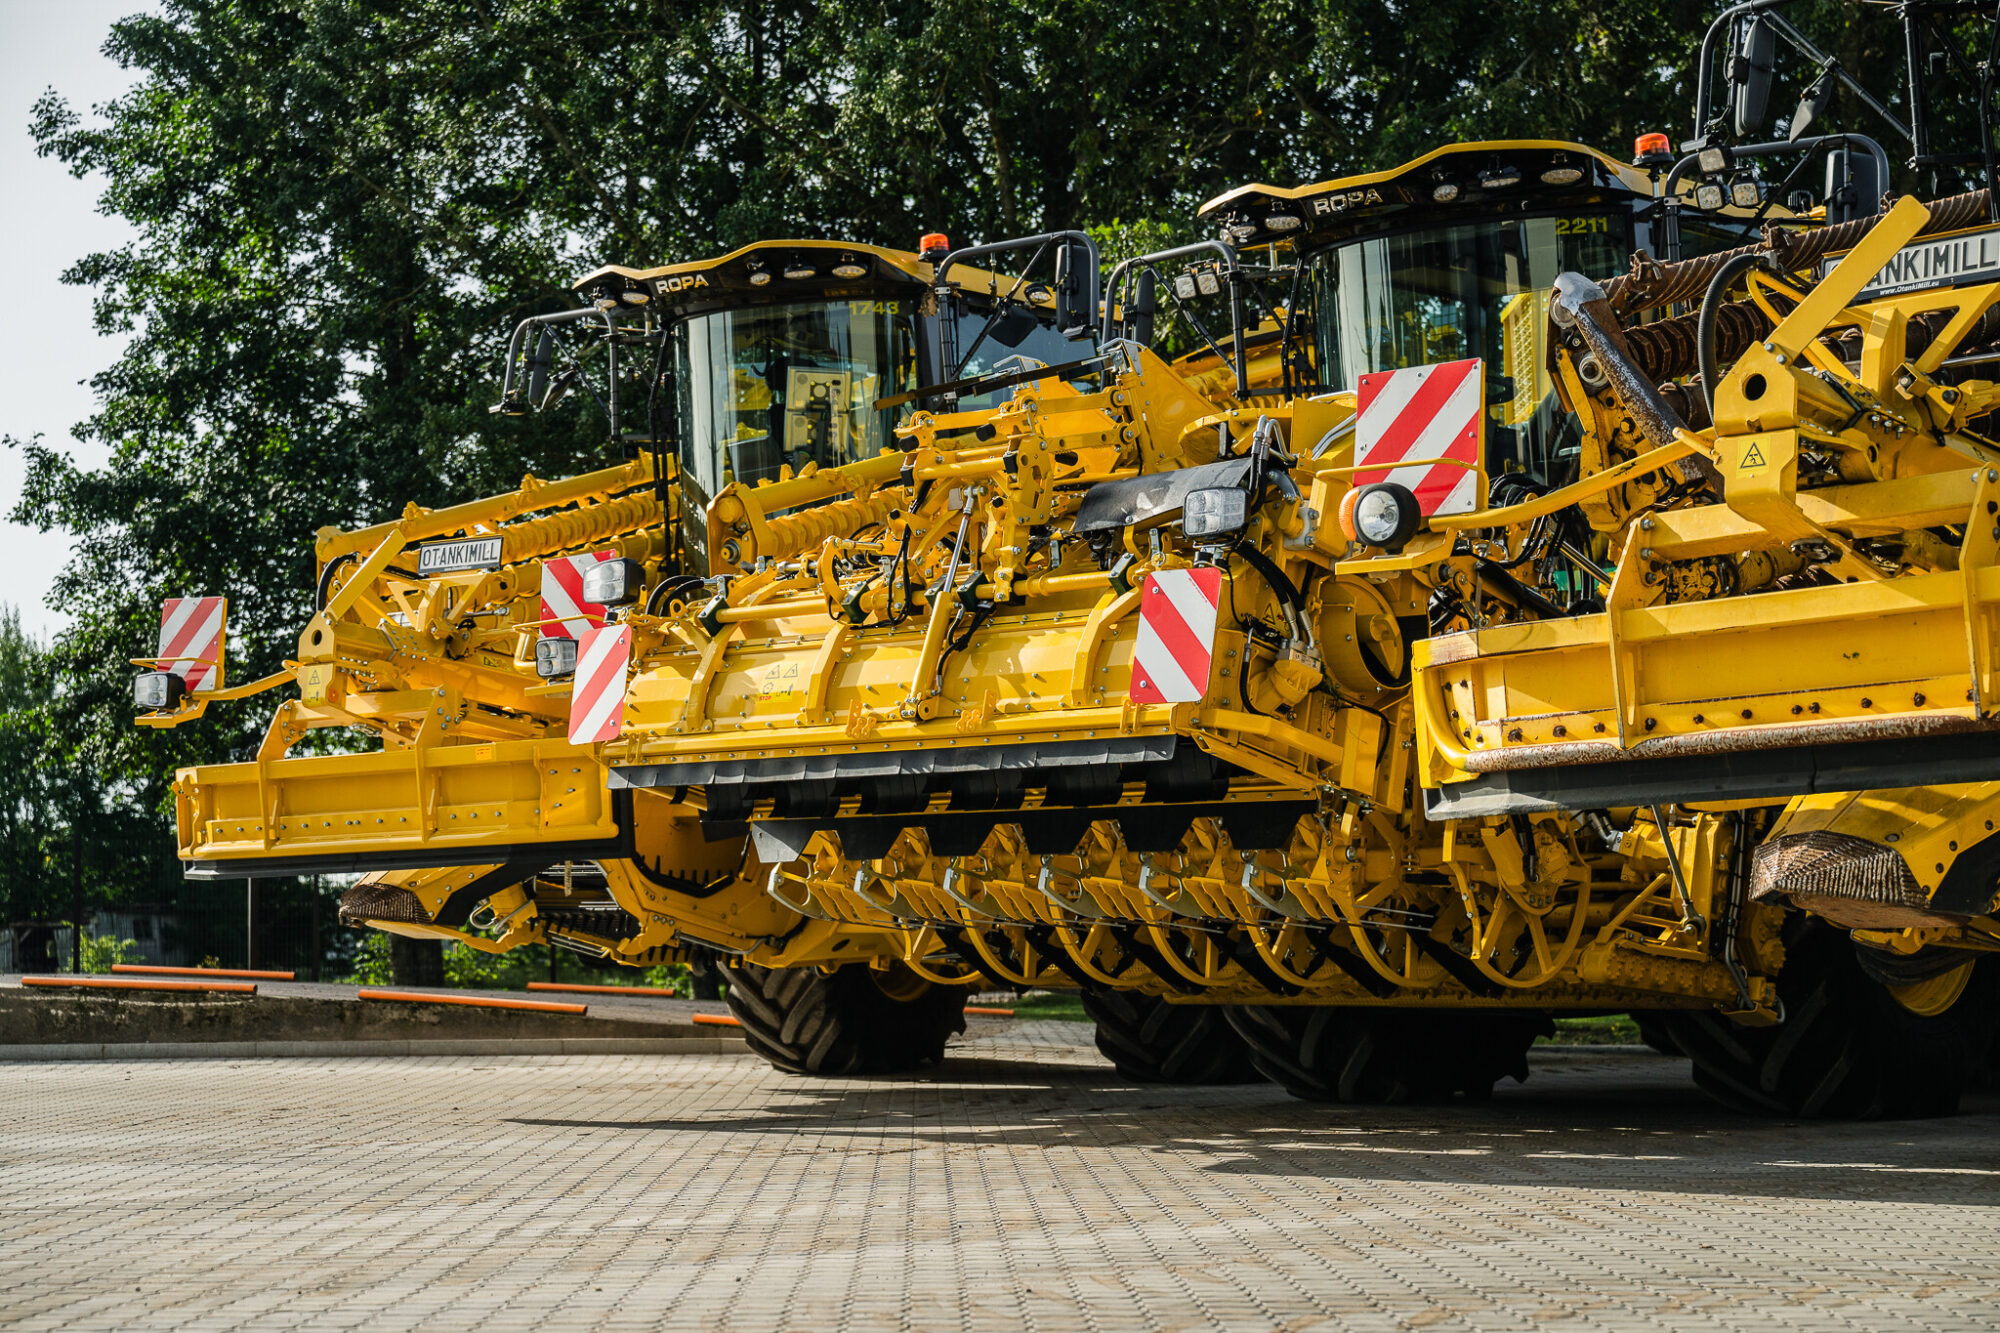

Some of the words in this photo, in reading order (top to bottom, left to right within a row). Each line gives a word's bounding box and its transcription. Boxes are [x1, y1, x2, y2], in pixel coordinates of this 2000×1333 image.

[1313, 188, 1383, 215] ROPA
[1555, 217, 1608, 234] 2211
[655, 274, 709, 294] ROPA
[849, 301, 899, 315] 1743
[422, 542, 498, 567] OTANKIMILL
